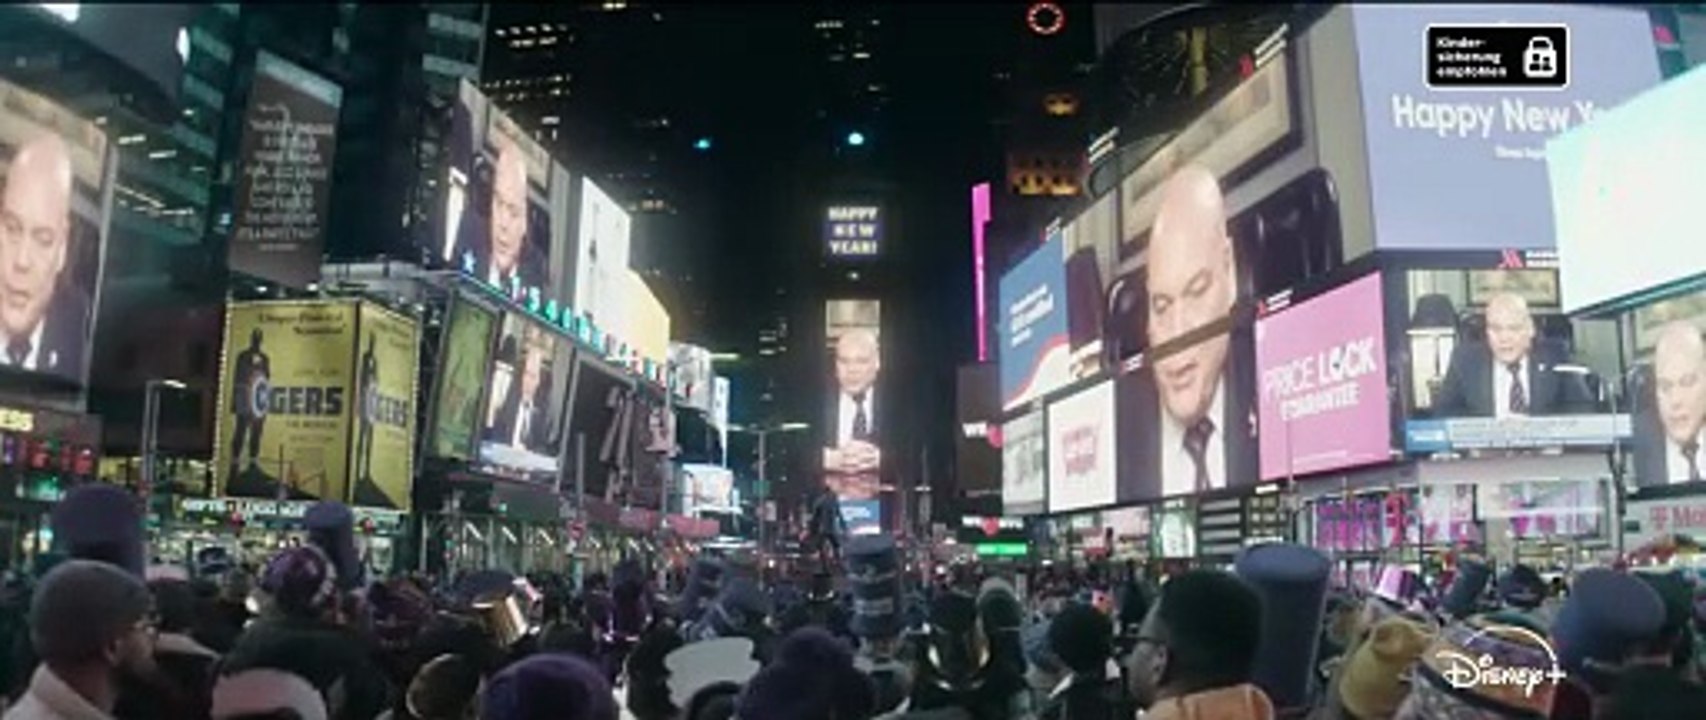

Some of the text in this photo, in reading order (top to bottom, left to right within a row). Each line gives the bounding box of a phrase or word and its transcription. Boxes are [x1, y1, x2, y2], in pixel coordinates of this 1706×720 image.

[1392, 94, 1494, 139] Happy
[1502, 97, 1570, 132] New
[828, 206, 878, 220] HAPPY
[834, 223, 876, 238] NEW
[829, 240, 877, 255] YEAR!
[1264, 336, 1377, 398] PRICE LOCK
